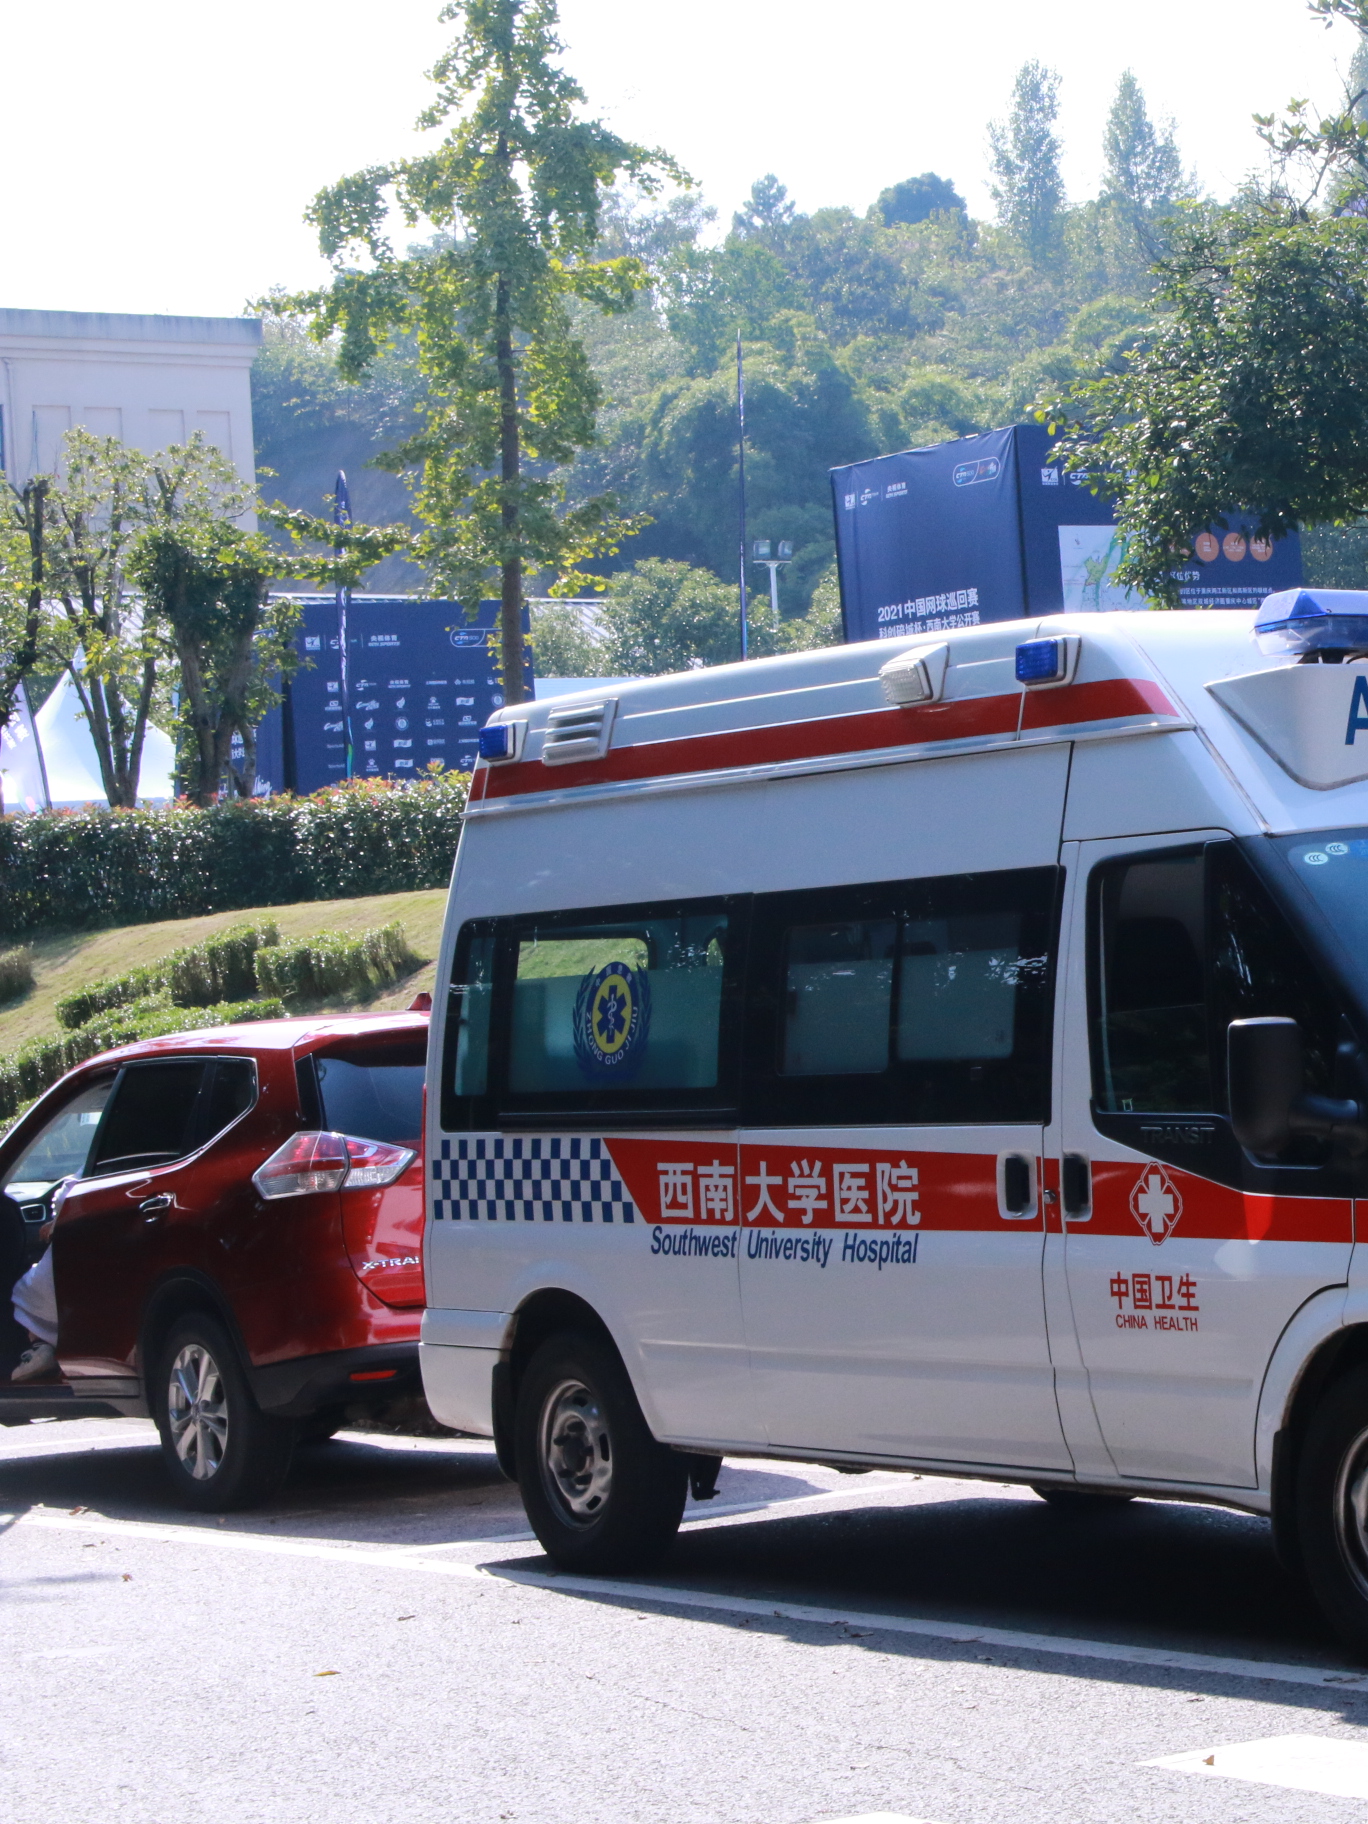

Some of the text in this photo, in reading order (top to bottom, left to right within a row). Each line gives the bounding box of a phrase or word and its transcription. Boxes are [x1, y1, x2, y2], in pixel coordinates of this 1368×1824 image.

[878, 587, 979, 622] 2021中国网球巡回赛
[604, 1049, 624, 1065] GUO
[1140, 1126, 1215, 1144] TRANSIT
[656, 1158, 922, 1226] 西南大学医院
[650, 1225, 919, 1271] Southwest University Hospital
[1109, 1271, 1200, 1312] 中国卫生
[1115, 1314, 1199, 1332] CHINA HEALTH
